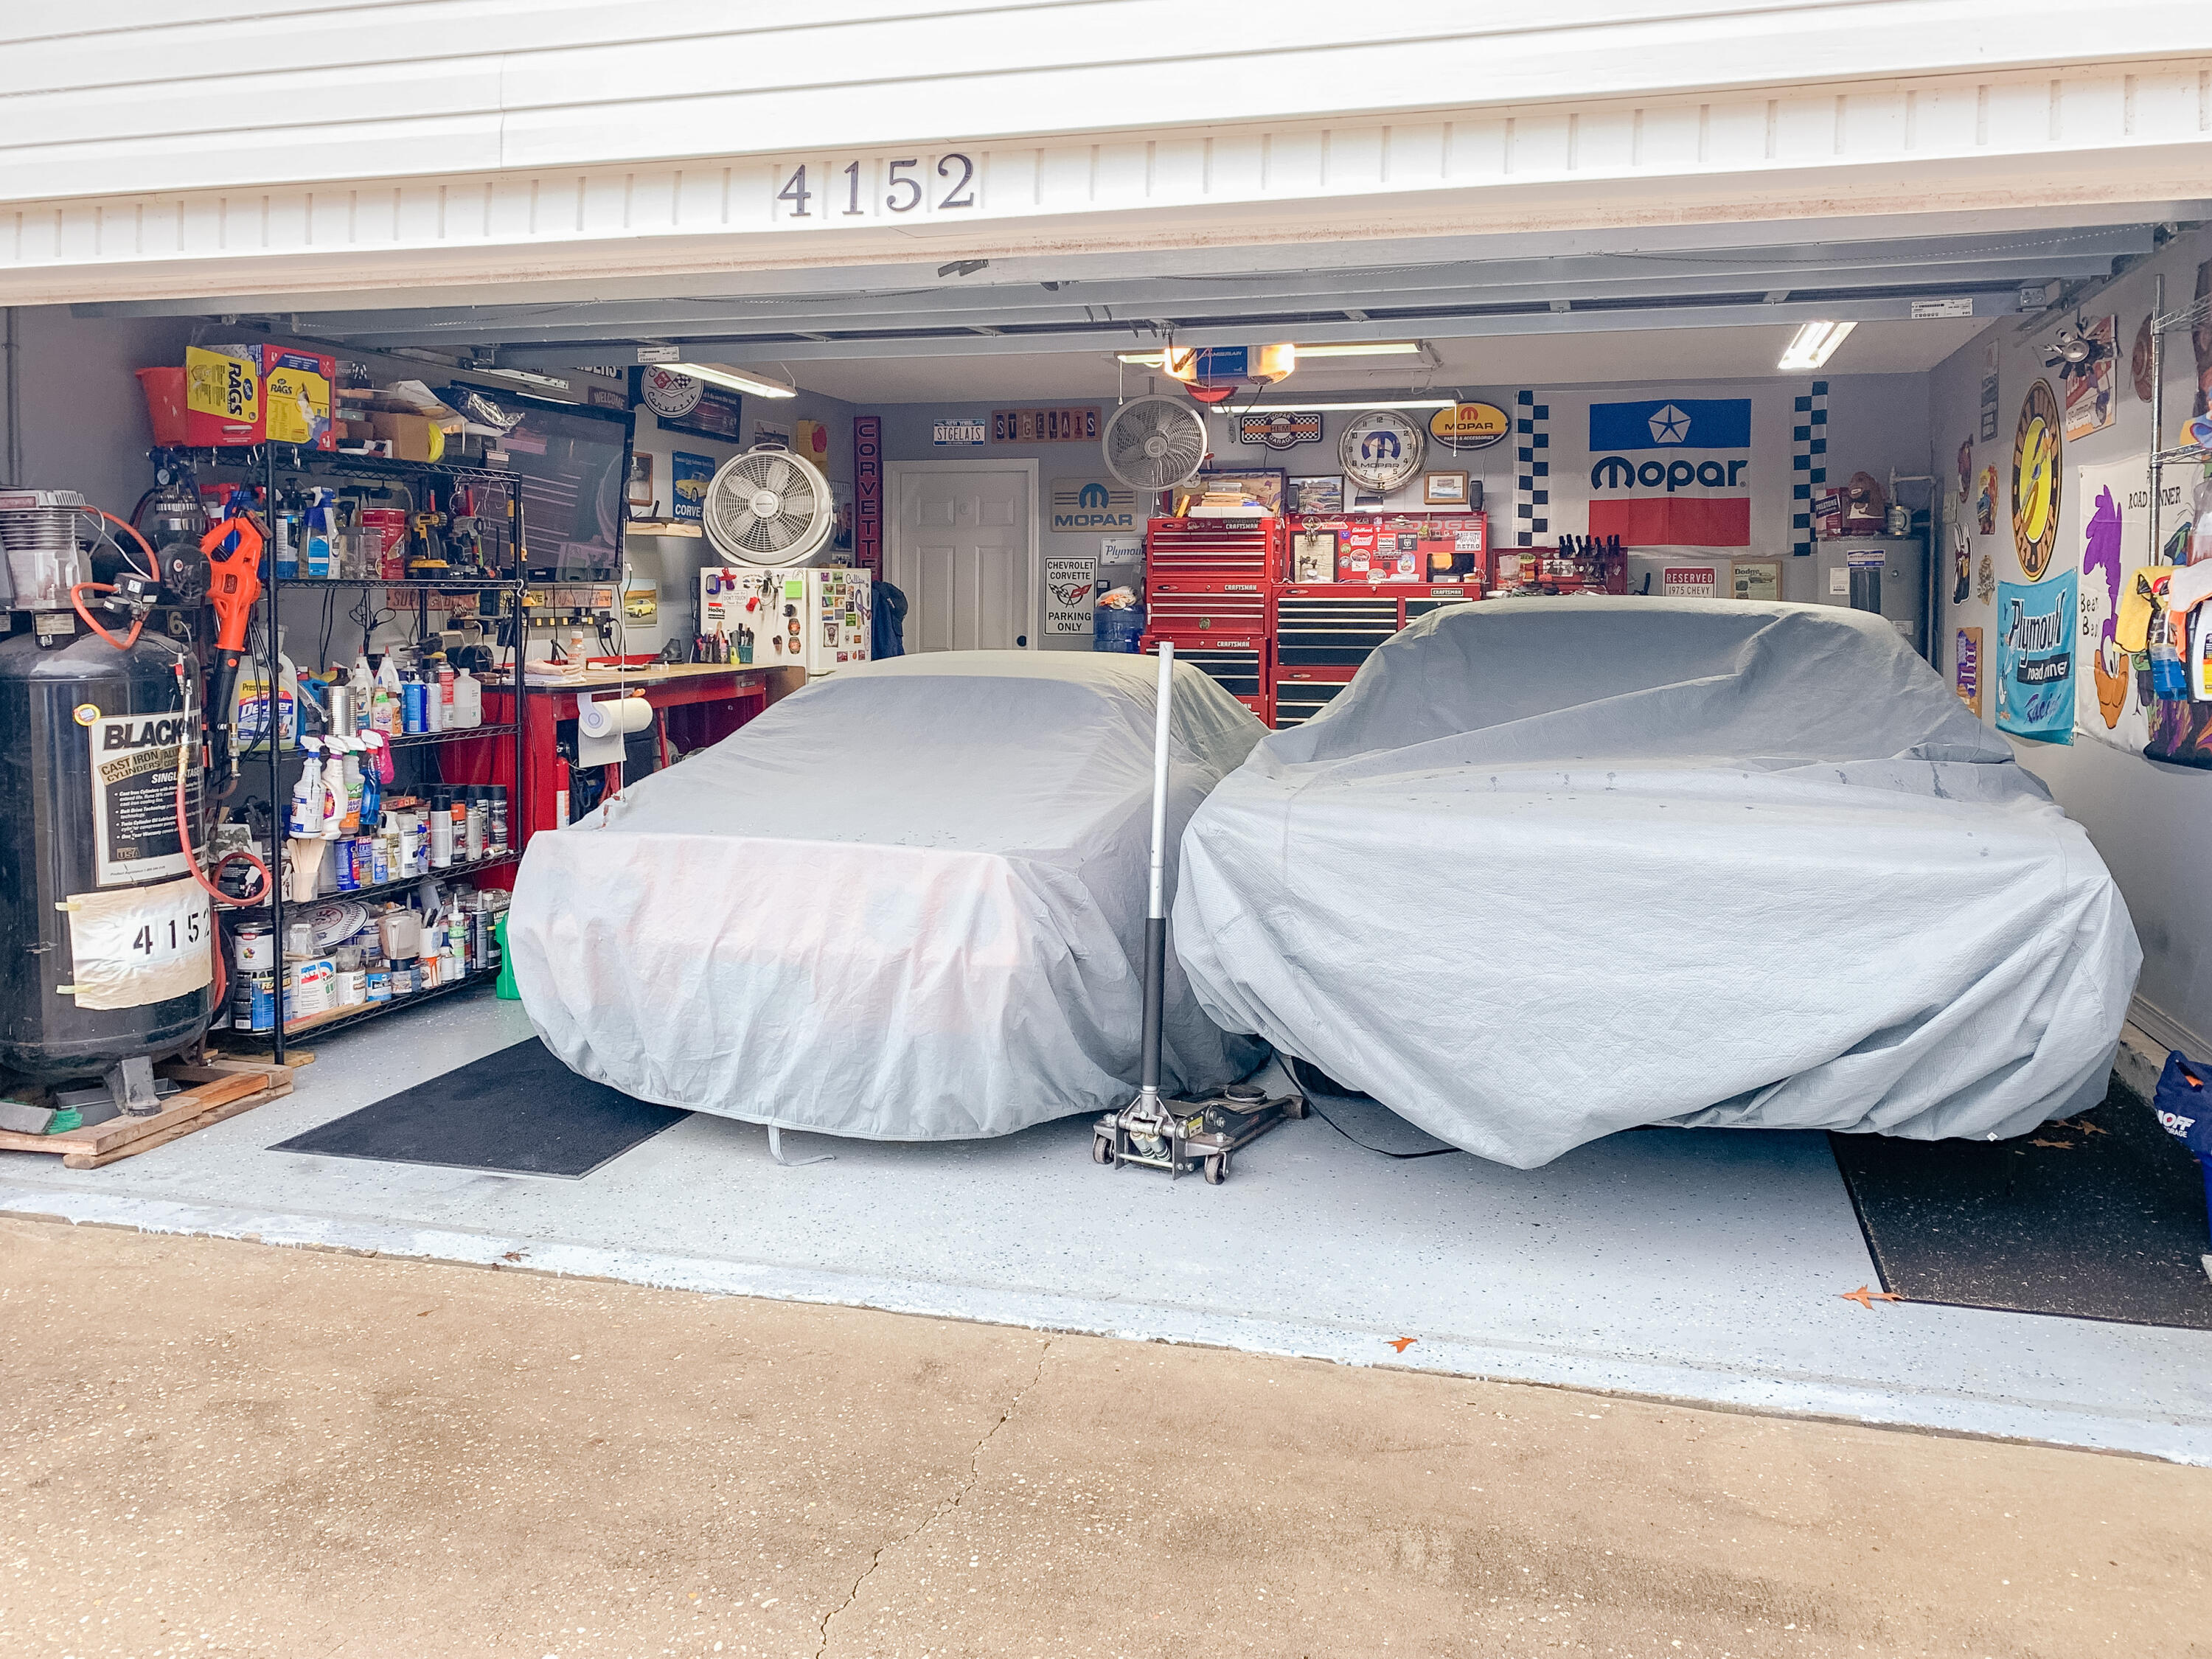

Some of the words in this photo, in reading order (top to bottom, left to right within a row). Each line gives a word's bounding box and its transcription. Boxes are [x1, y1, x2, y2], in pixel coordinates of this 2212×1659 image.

[777, 153, 974, 216] 4152
[228, 362, 243, 416] RAGS
[270, 383, 293, 395] RAGS
[594, 392, 625, 409] WELCOME
[647, 391, 697, 412] Corvette
[1270, 412, 1291, 423] MOPAR
[1445, 422, 1494, 431] MOPAR
[937, 427, 981, 441] STGELAIS
[1268, 434, 1293, 445] GARAGE
[1590, 456, 1747, 492] Mopar
[858, 424, 876, 575] CORVETTE
[2128, 492, 2148, 509] ROAD
[2152, 487, 2181, 507] NNER
[675, 504, 701, 516] CORVE
[1054, 514, 1133, 526] MOPAR
[1105, 545, 1145, 559] Plymou
[1047, 561, 1093, 570] CHEVROLET
[1050, 571, 1091, 580] CORVETTE
[1666, 573, 1713, 583] RESERVED
[1669, 586, 1685, 595] 1975
[1687, 586, 1710, 595] CHEVY
[168, 611, 184, 635] 6
[1048, 612, 1091, 621] PARKING
[1057, 623, 1082, 632] ONLY
[101, 757, 131, 776] CAST
[133, 750, 159, 765] IRON
[106, 760, 161, 782] CYLINDERS
[150, 771, 178, 785] SINGL
[117, 849, 141, 860] USA
[133, 908, 210, 955] 4152
